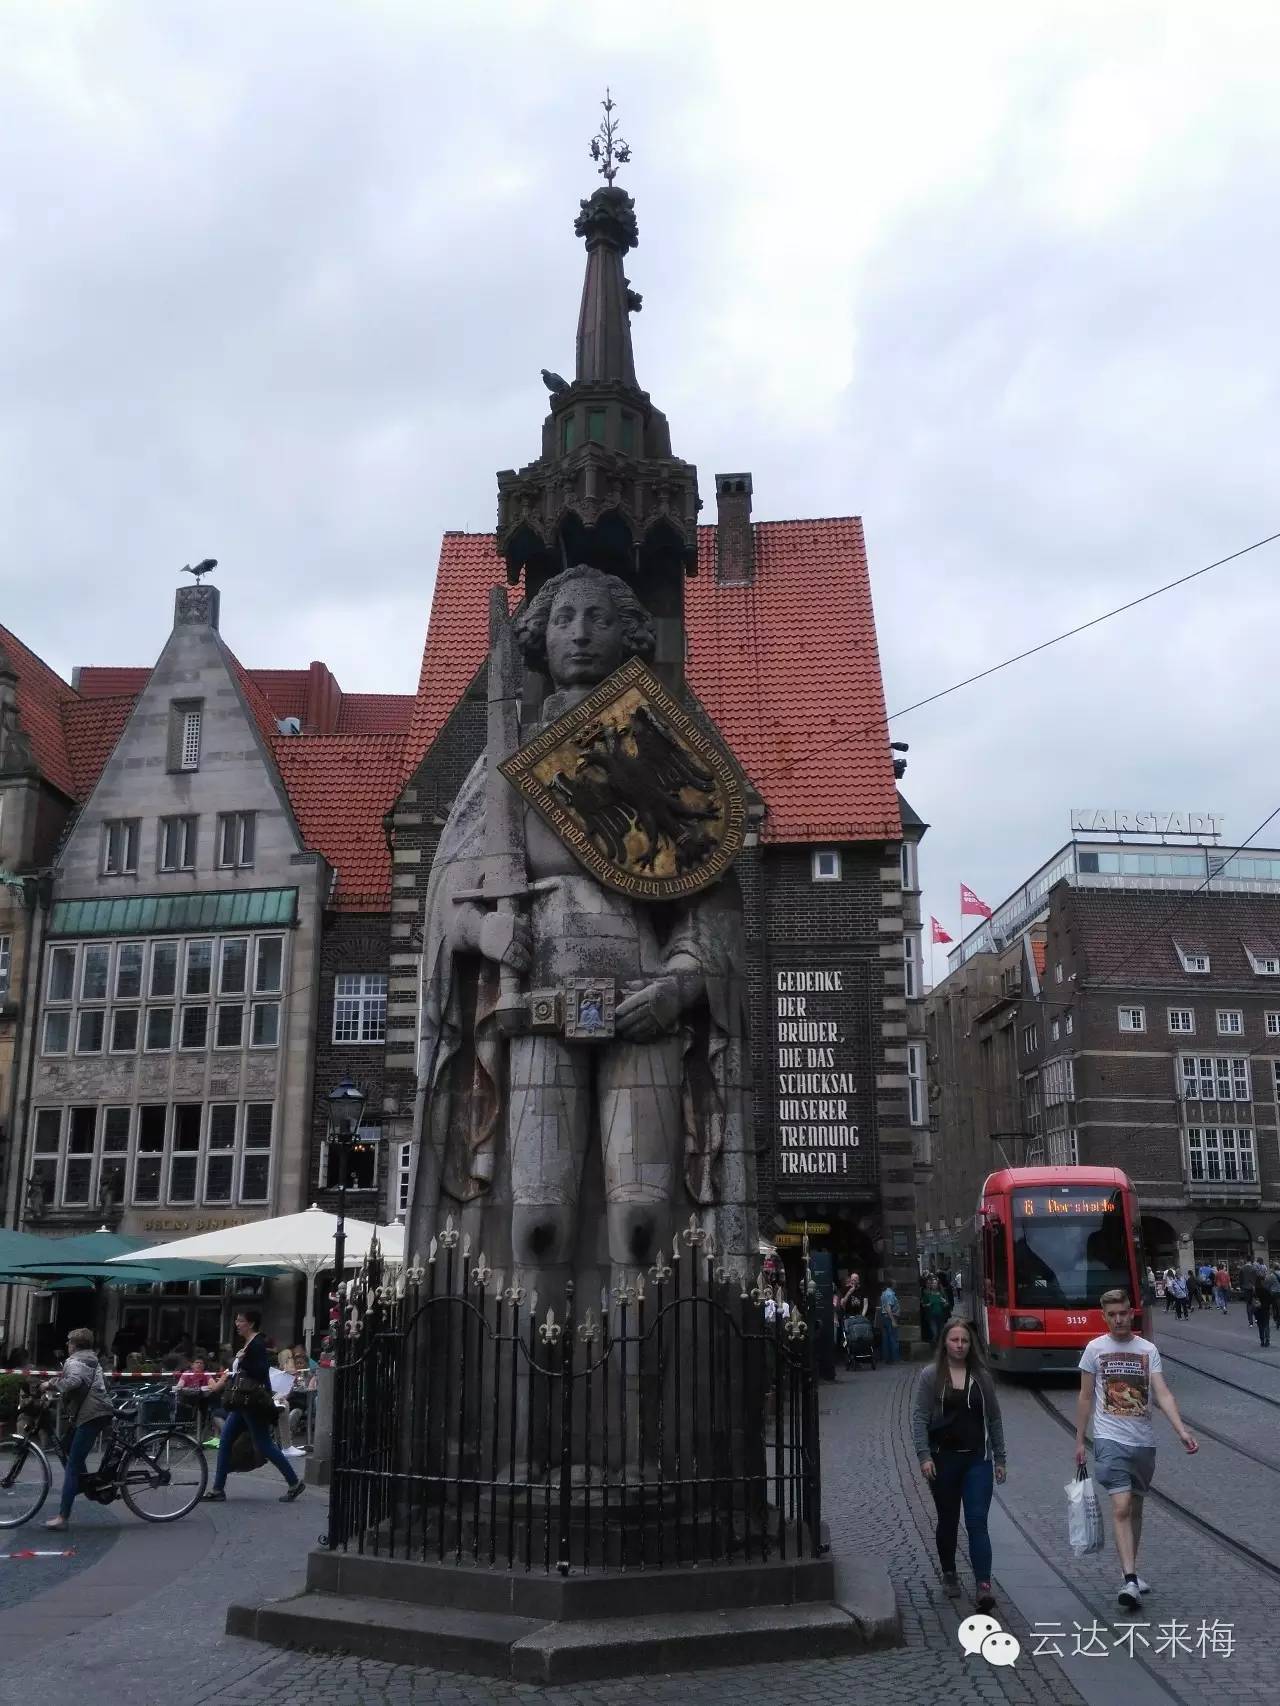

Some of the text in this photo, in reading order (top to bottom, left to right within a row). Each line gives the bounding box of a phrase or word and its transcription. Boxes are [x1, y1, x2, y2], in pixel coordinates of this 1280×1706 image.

[1071, 808, 1225, 834] KARSTADT
[777, 971, 843, 991] GEDENKE
[777, 997, 806, 1017] DER
[778, 1019, 846, 1043] BRÜDER,
[779, 1048, 834, 1068] DIE DAS
[779, 1073, 857, 1094] SCHICKSAL
[779, 1100, 848, 1120] UNSERER
[779, 1125, 859, 1147] TRENNUNG
[1066, 1316, 1087, 1324] 3119
